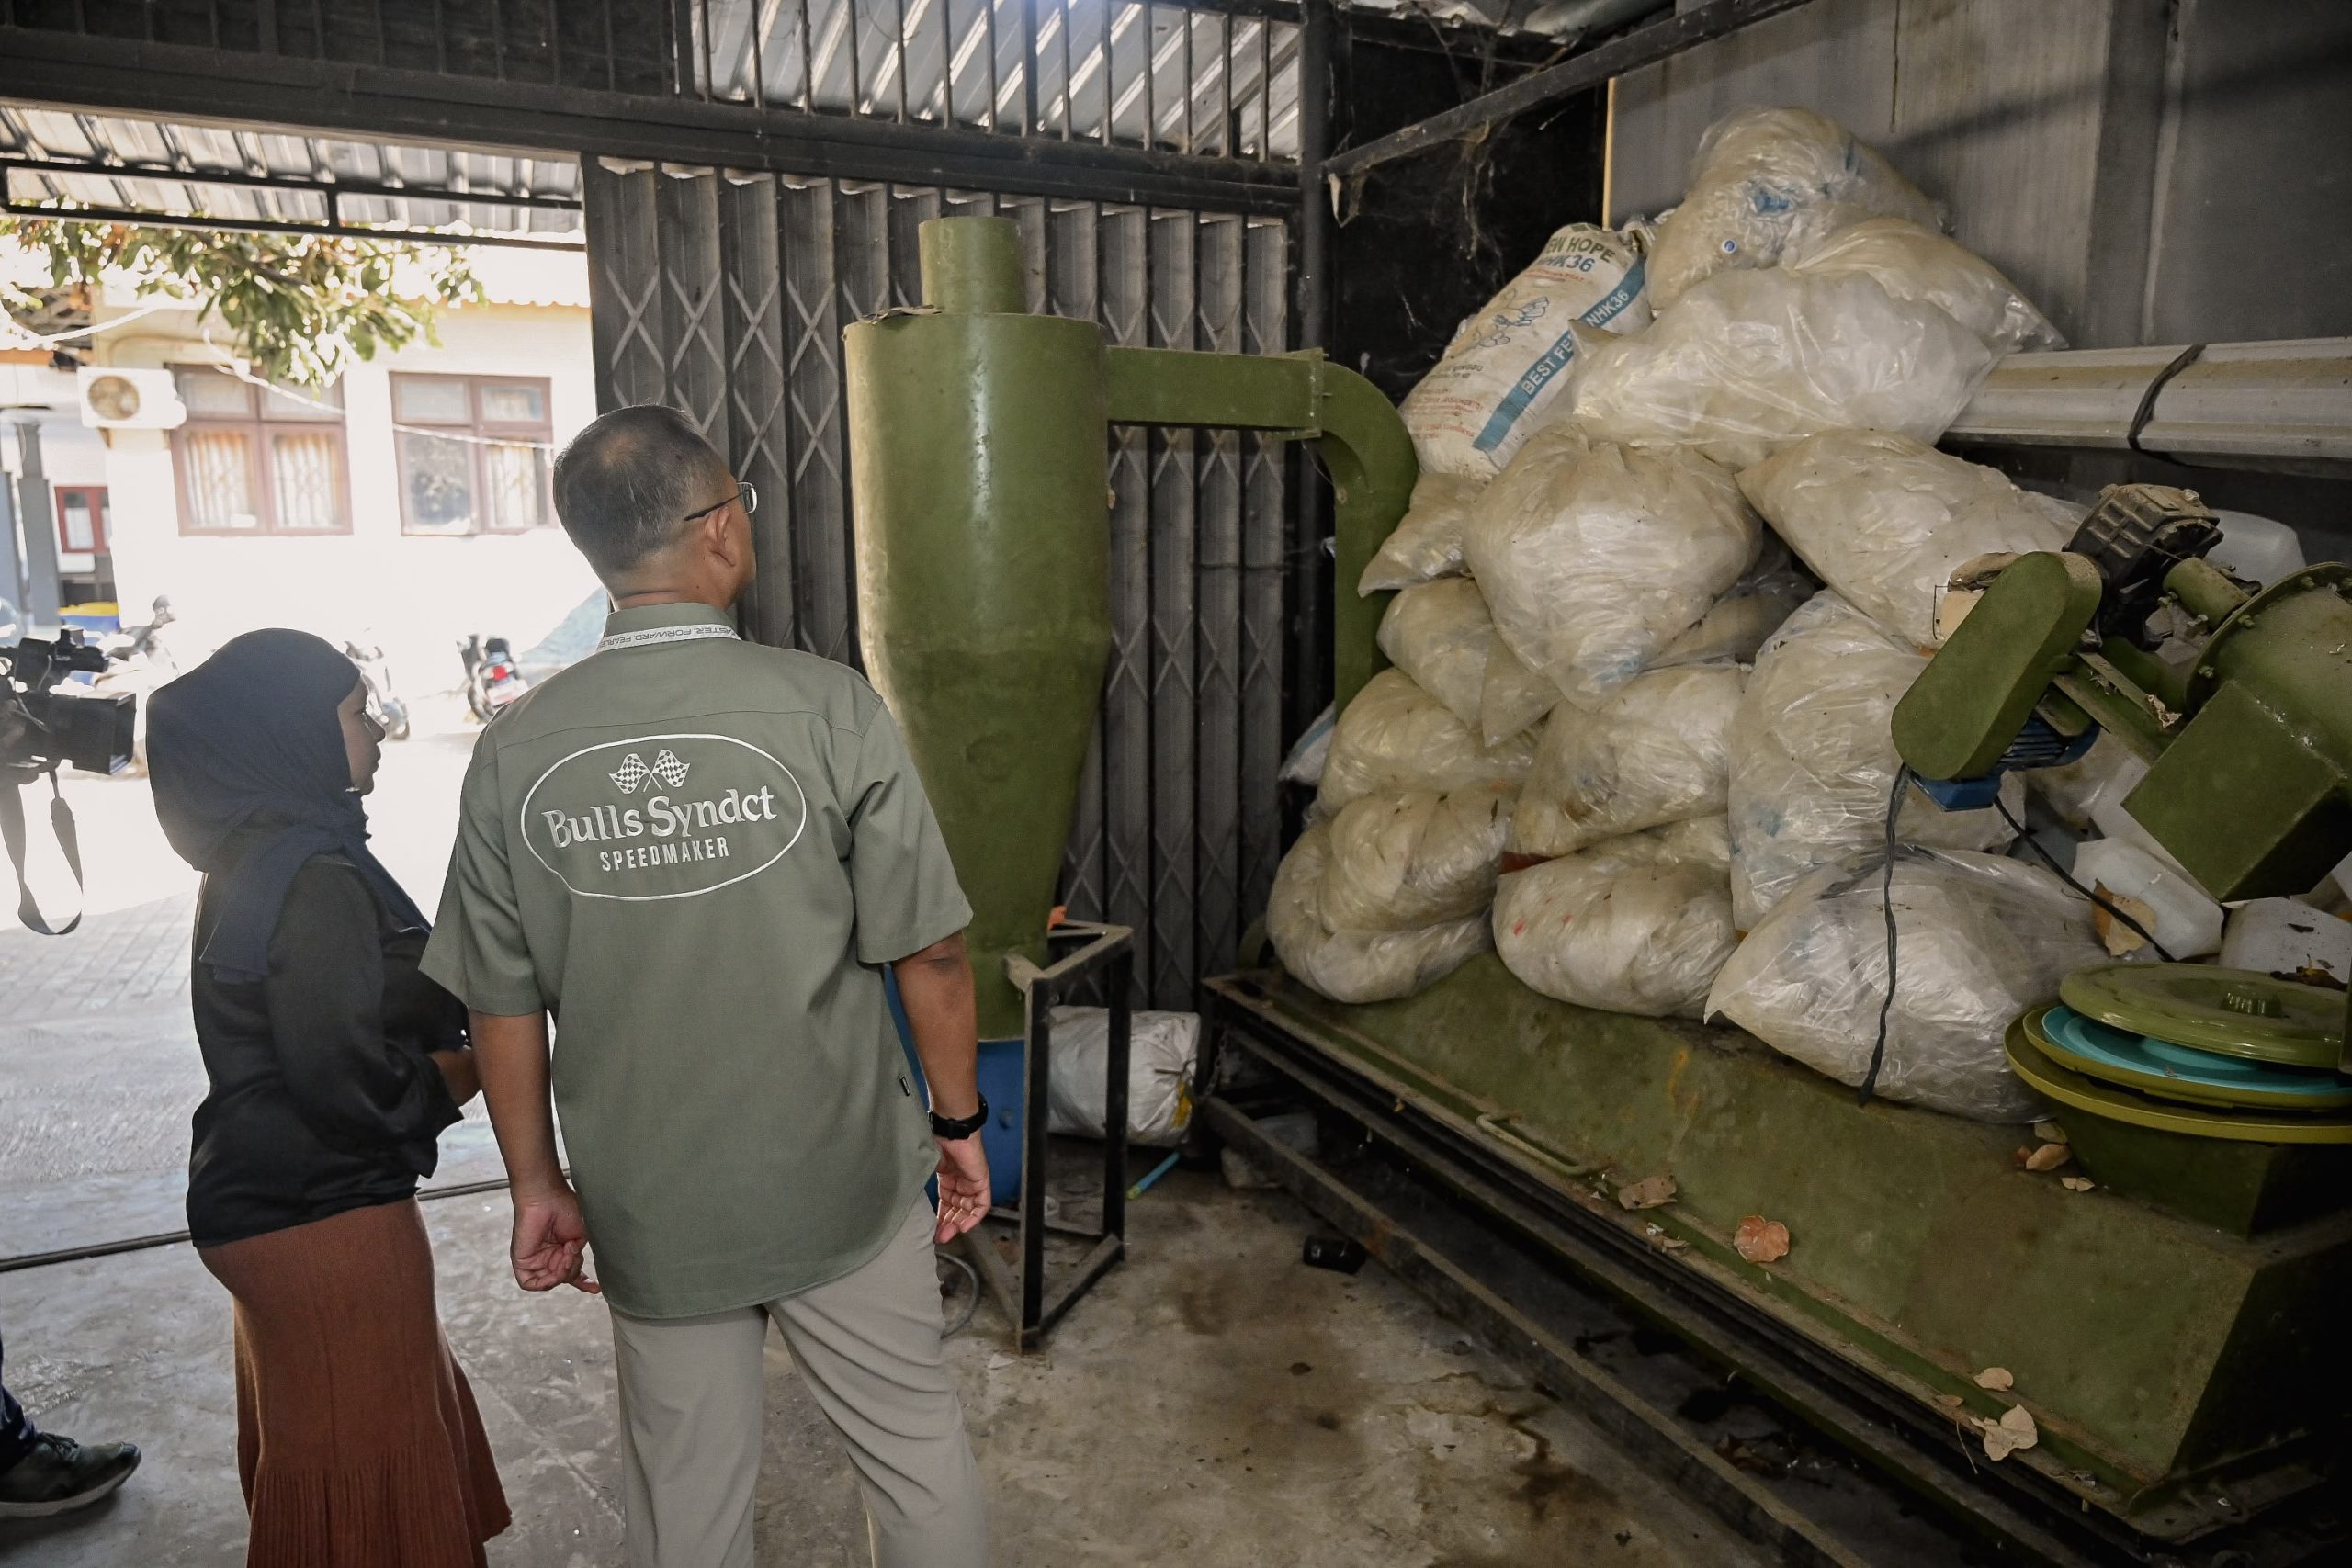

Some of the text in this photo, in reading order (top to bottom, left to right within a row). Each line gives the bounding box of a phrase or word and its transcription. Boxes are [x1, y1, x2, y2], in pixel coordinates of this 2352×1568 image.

[1541, 254, 1596, 273] HK36
[1546, 236, 1615, 264] EW HOPE
[1521, 289, 1629, 395] BEST FE NHK36
[634, 629, 692, 641] FORWARD.
[541, 785, 778, 848] Bulls Syndct
[599, 837, 729, 872] SPEEDMAKER
